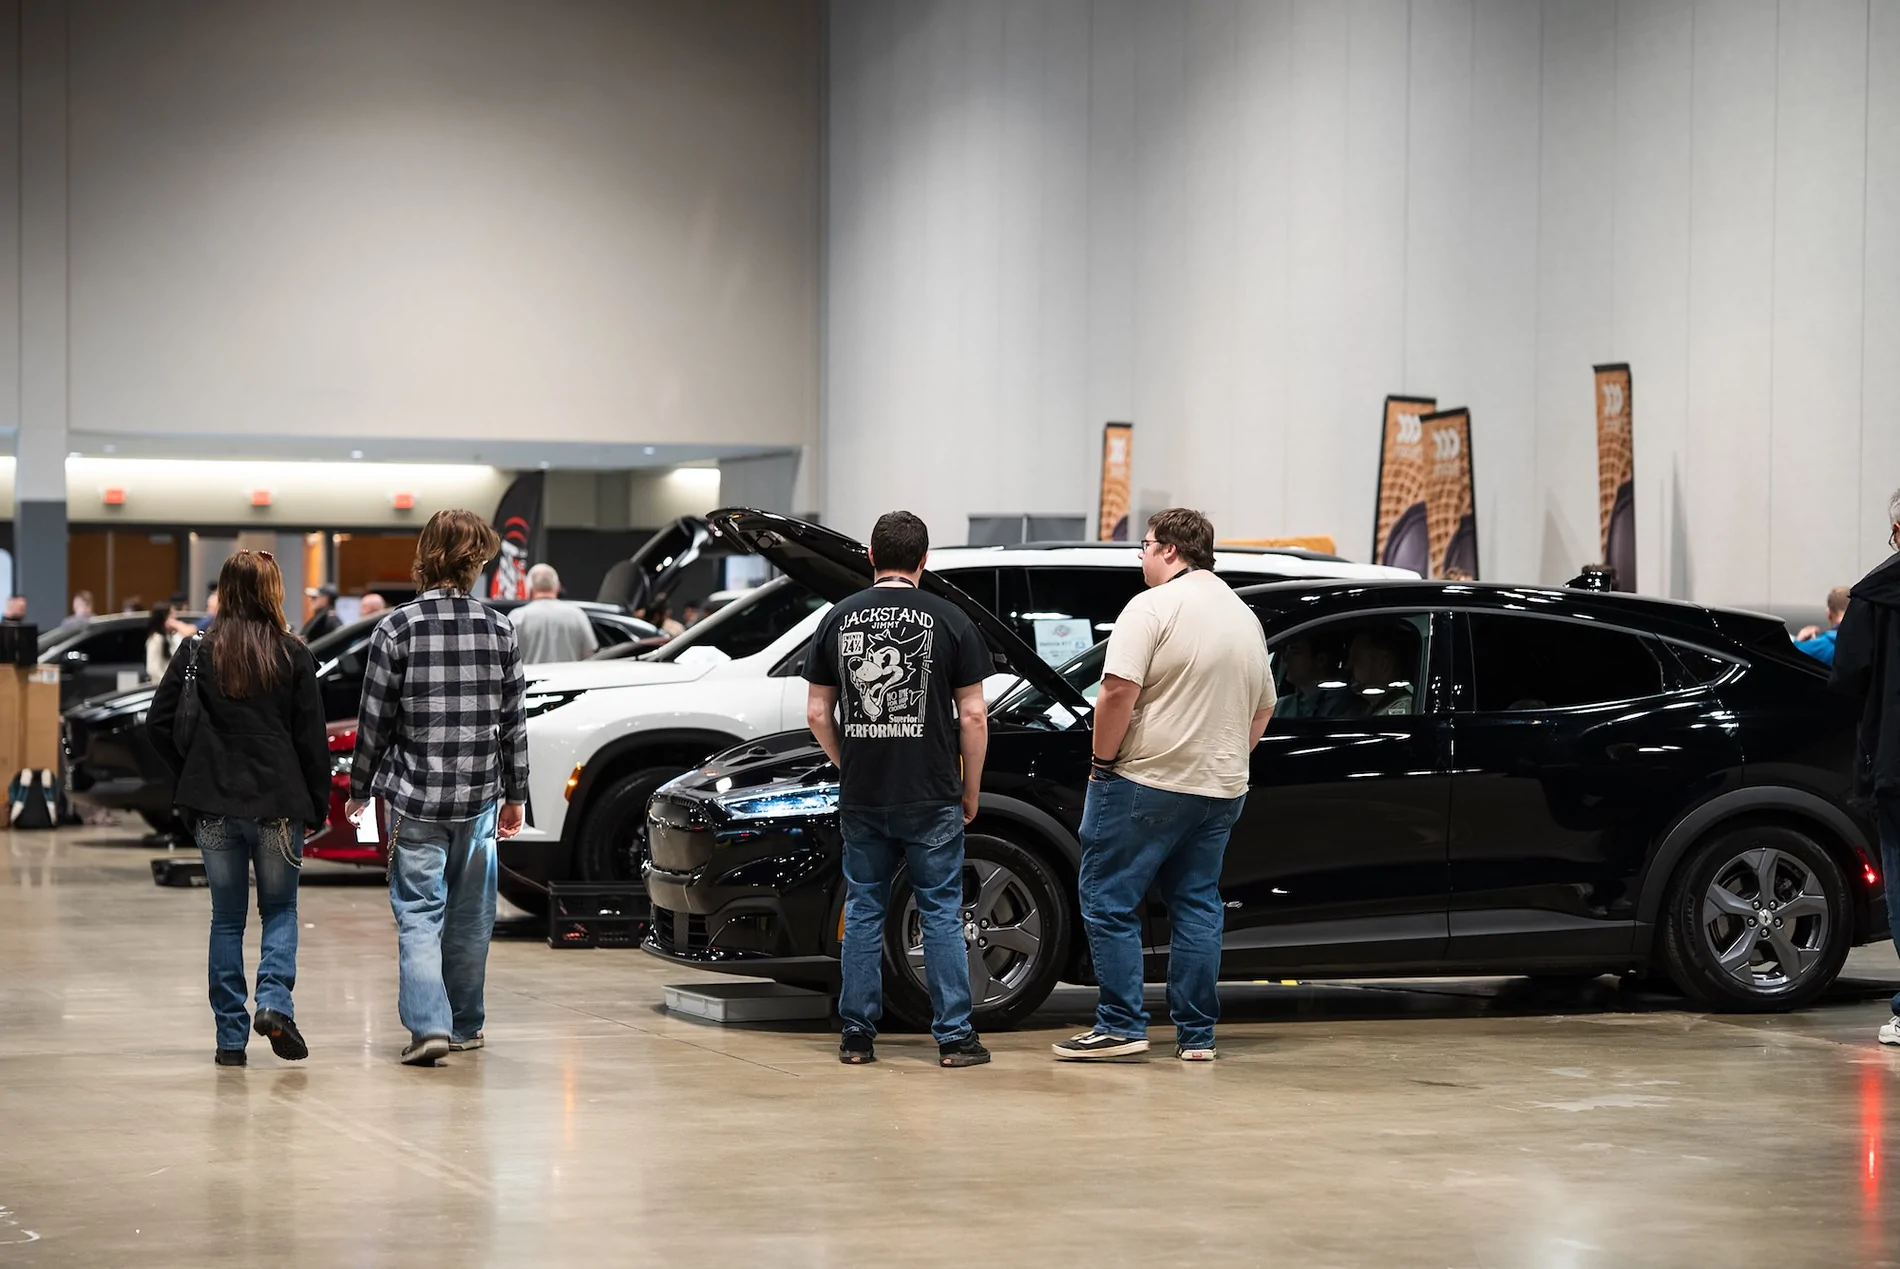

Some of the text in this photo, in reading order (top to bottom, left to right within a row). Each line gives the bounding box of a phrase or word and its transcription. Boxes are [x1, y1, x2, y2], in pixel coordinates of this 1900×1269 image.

[839, 607, 934, 631] JACKSTAND
[871, 621, 900, 629] JIMMY
[844, 723, 924, 738] PERFORMANCE
